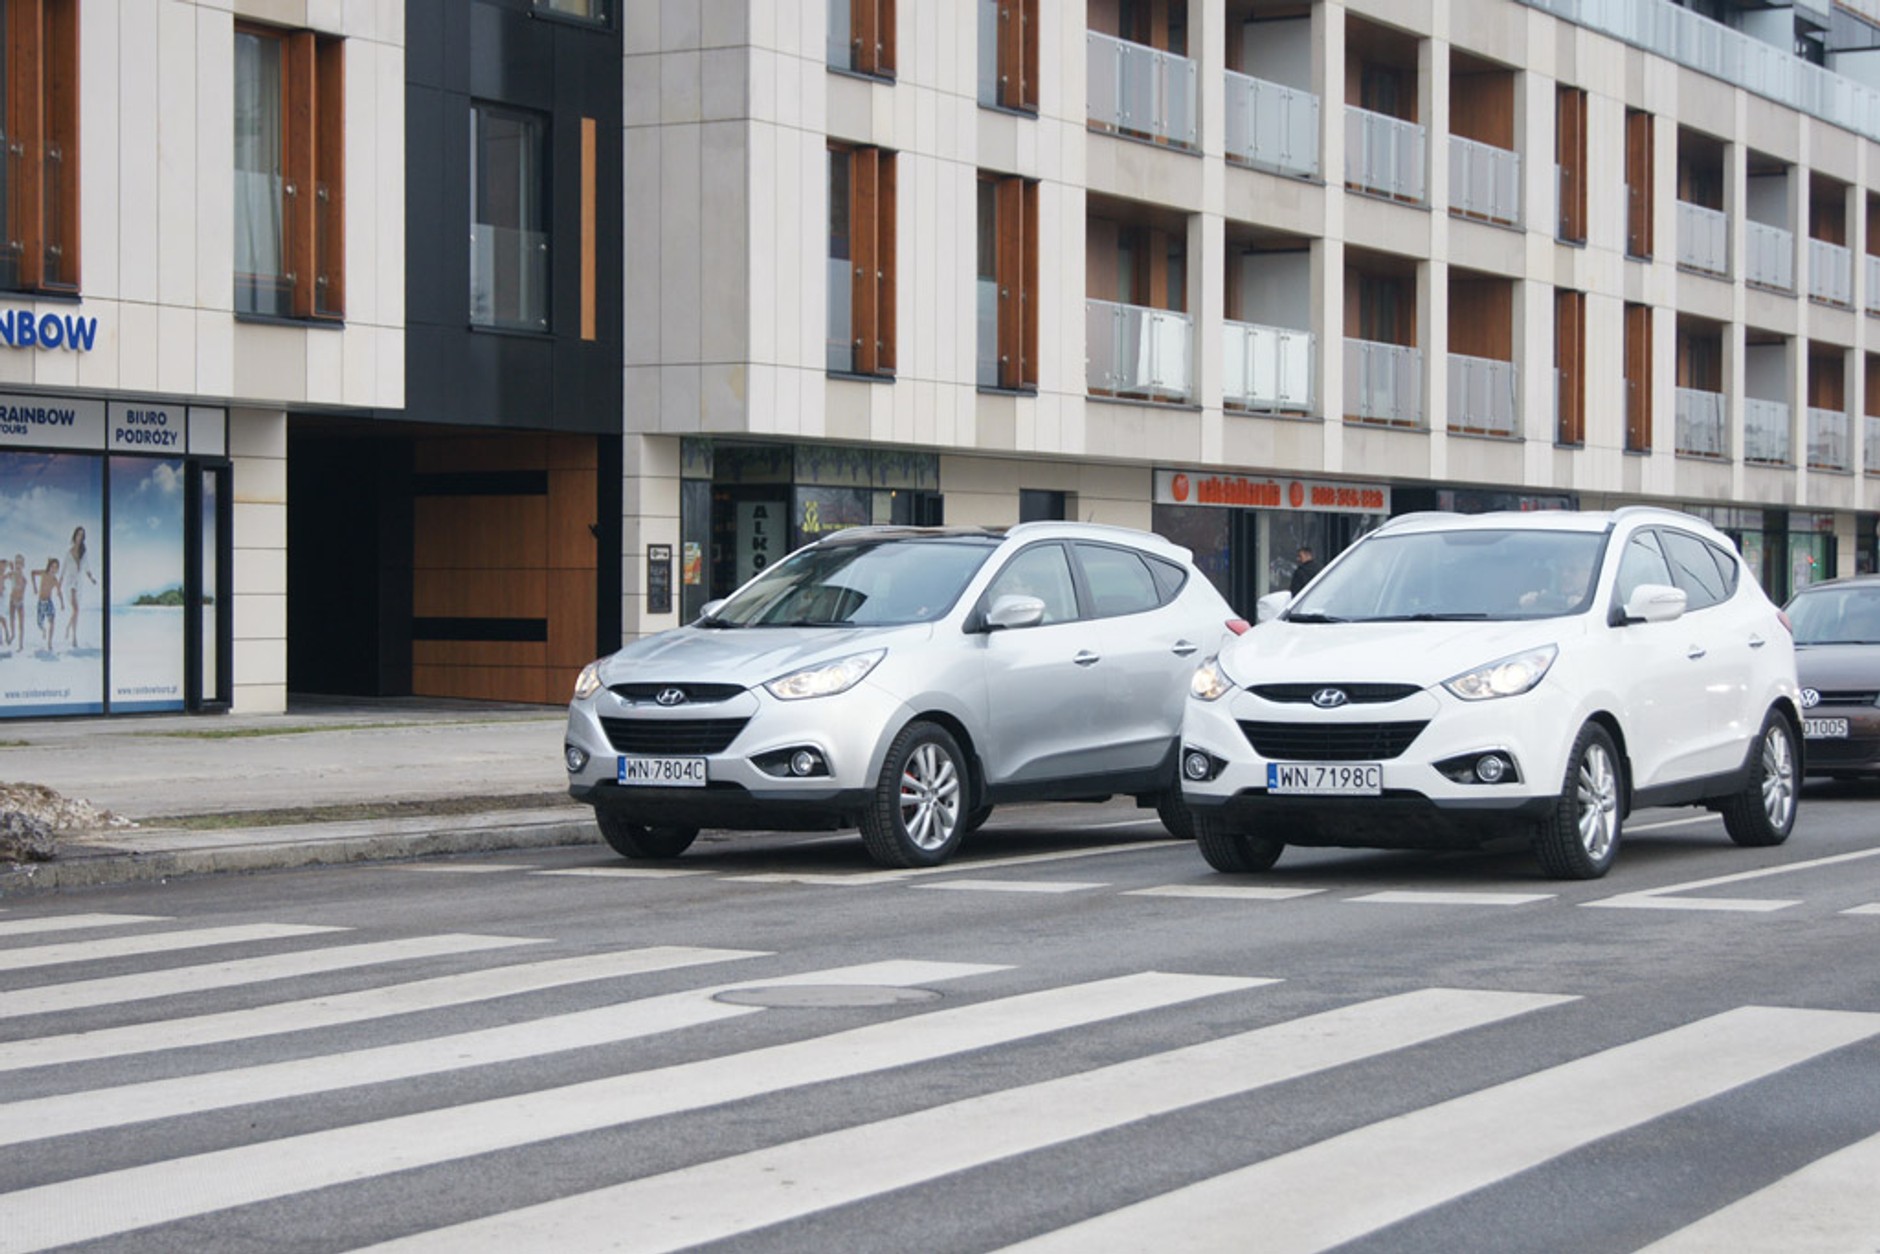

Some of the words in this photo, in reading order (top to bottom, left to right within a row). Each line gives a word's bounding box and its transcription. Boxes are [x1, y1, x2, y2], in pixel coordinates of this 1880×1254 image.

[0, 405, 75, 425] RAINBOW
[126, 409, 167, 426] BIURO
[752, 504, 768, 578] ALKO
[627, 760, 649, 779] WN
[654, 760, 703, 780] 7804C
[1281, 767, 1308, 787] WN
[1315, 767, 1378, 788] 7198C
